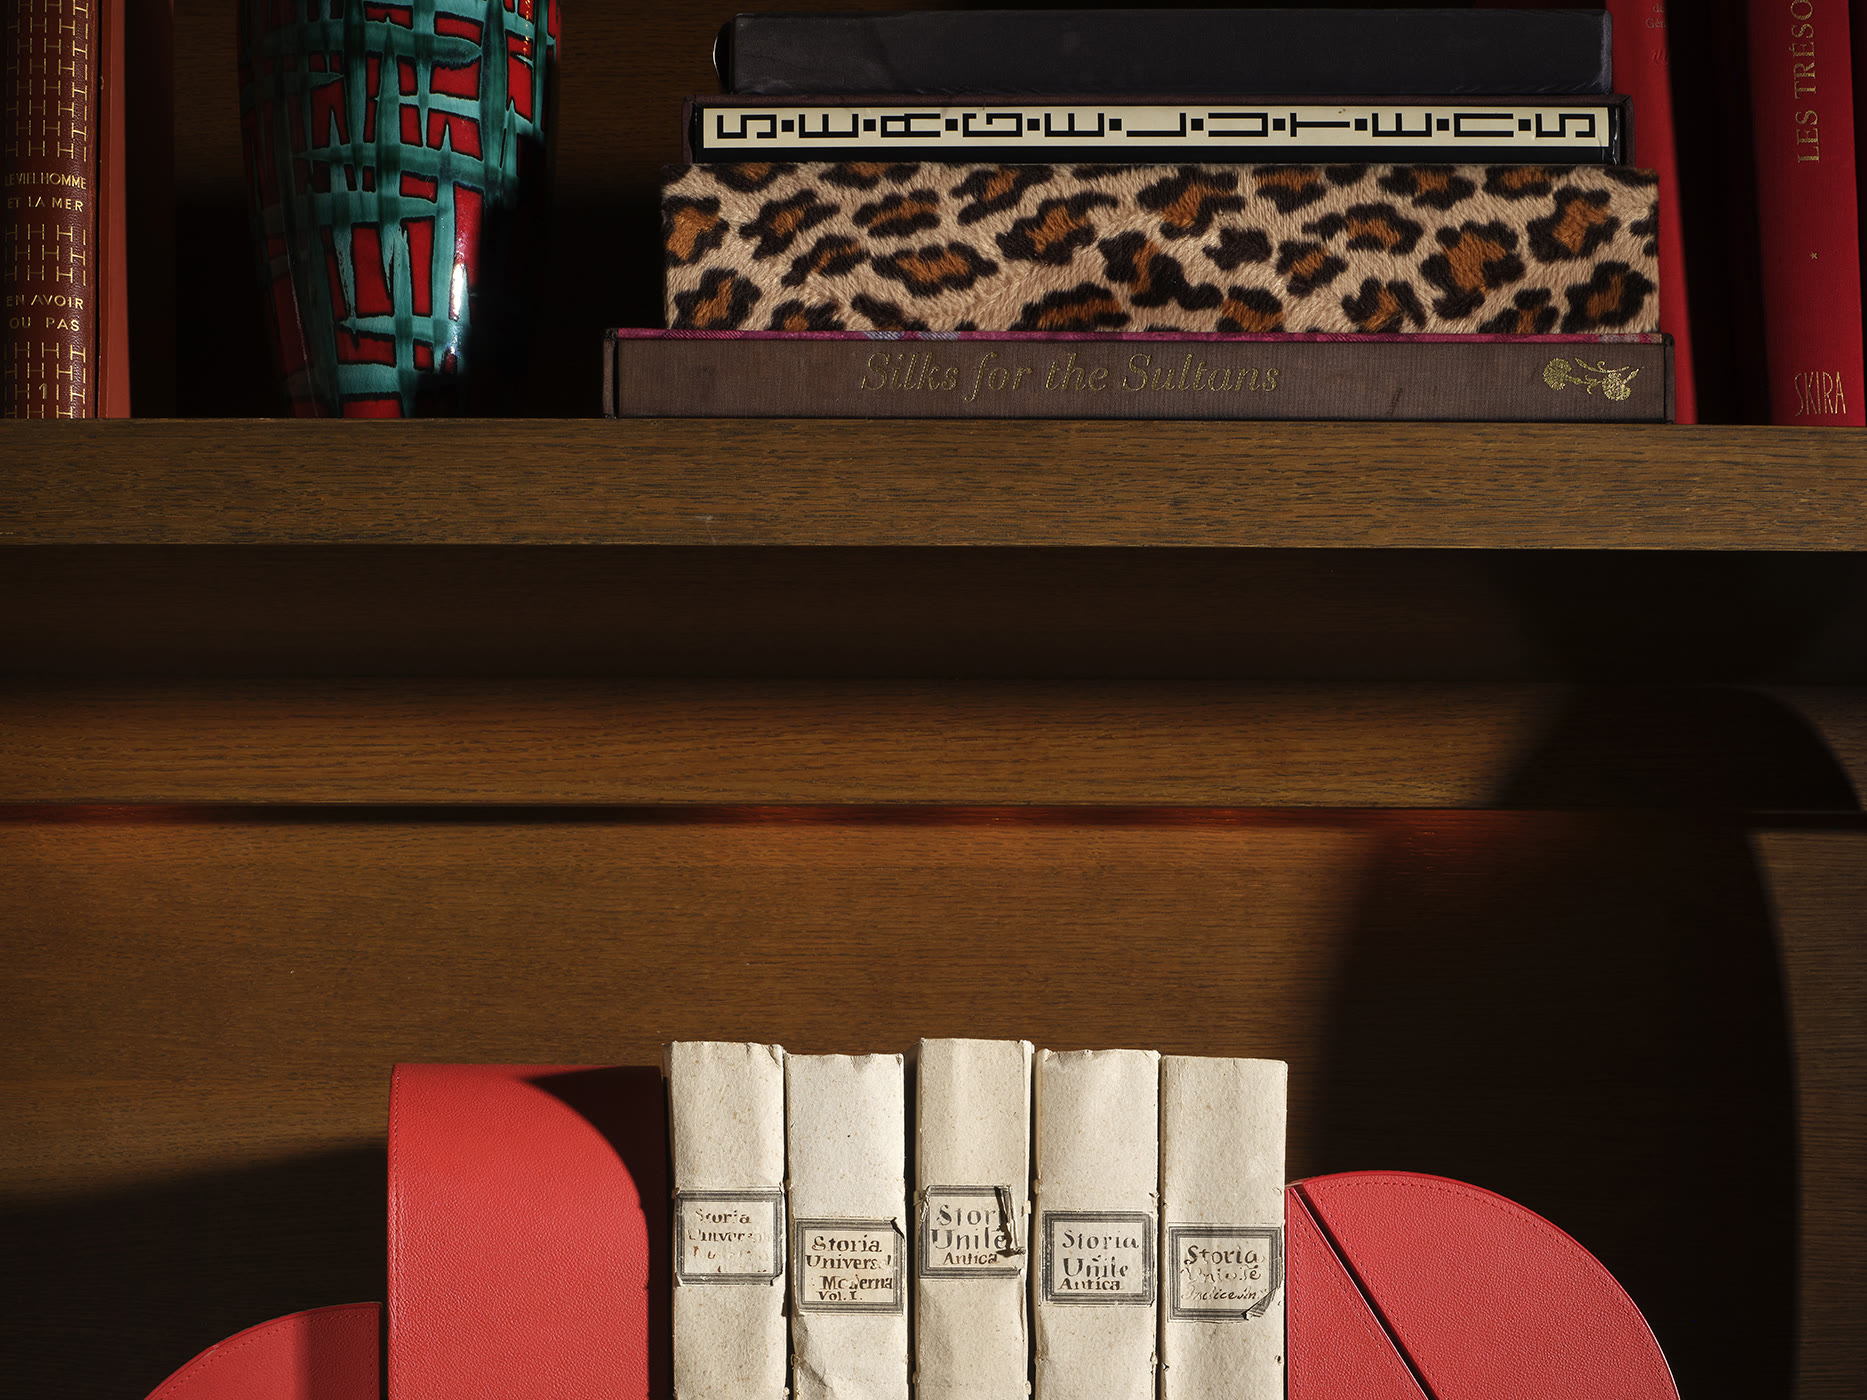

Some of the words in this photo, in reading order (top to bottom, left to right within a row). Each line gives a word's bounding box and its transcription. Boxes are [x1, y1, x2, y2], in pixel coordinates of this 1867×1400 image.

[1795, 110, 1821, 163] LES
[40, 172, 87, 190] HOMME
[52, 196, 84, 213] MER
[30, 294, 84, 310] AVOIR
[9, 316, 31, 329] OU
[46, 317, 80, 332] PAS
[860, 352, 959, 391] Silks
[964, 350, 1034, 402] for
[1045, 351, 1109, 391] the
[1122, 352, 1280, 392] Sultans
[1794, 370, 1847, 417] SKIRA
[1062, 1229, 1140, 1250] Storia
